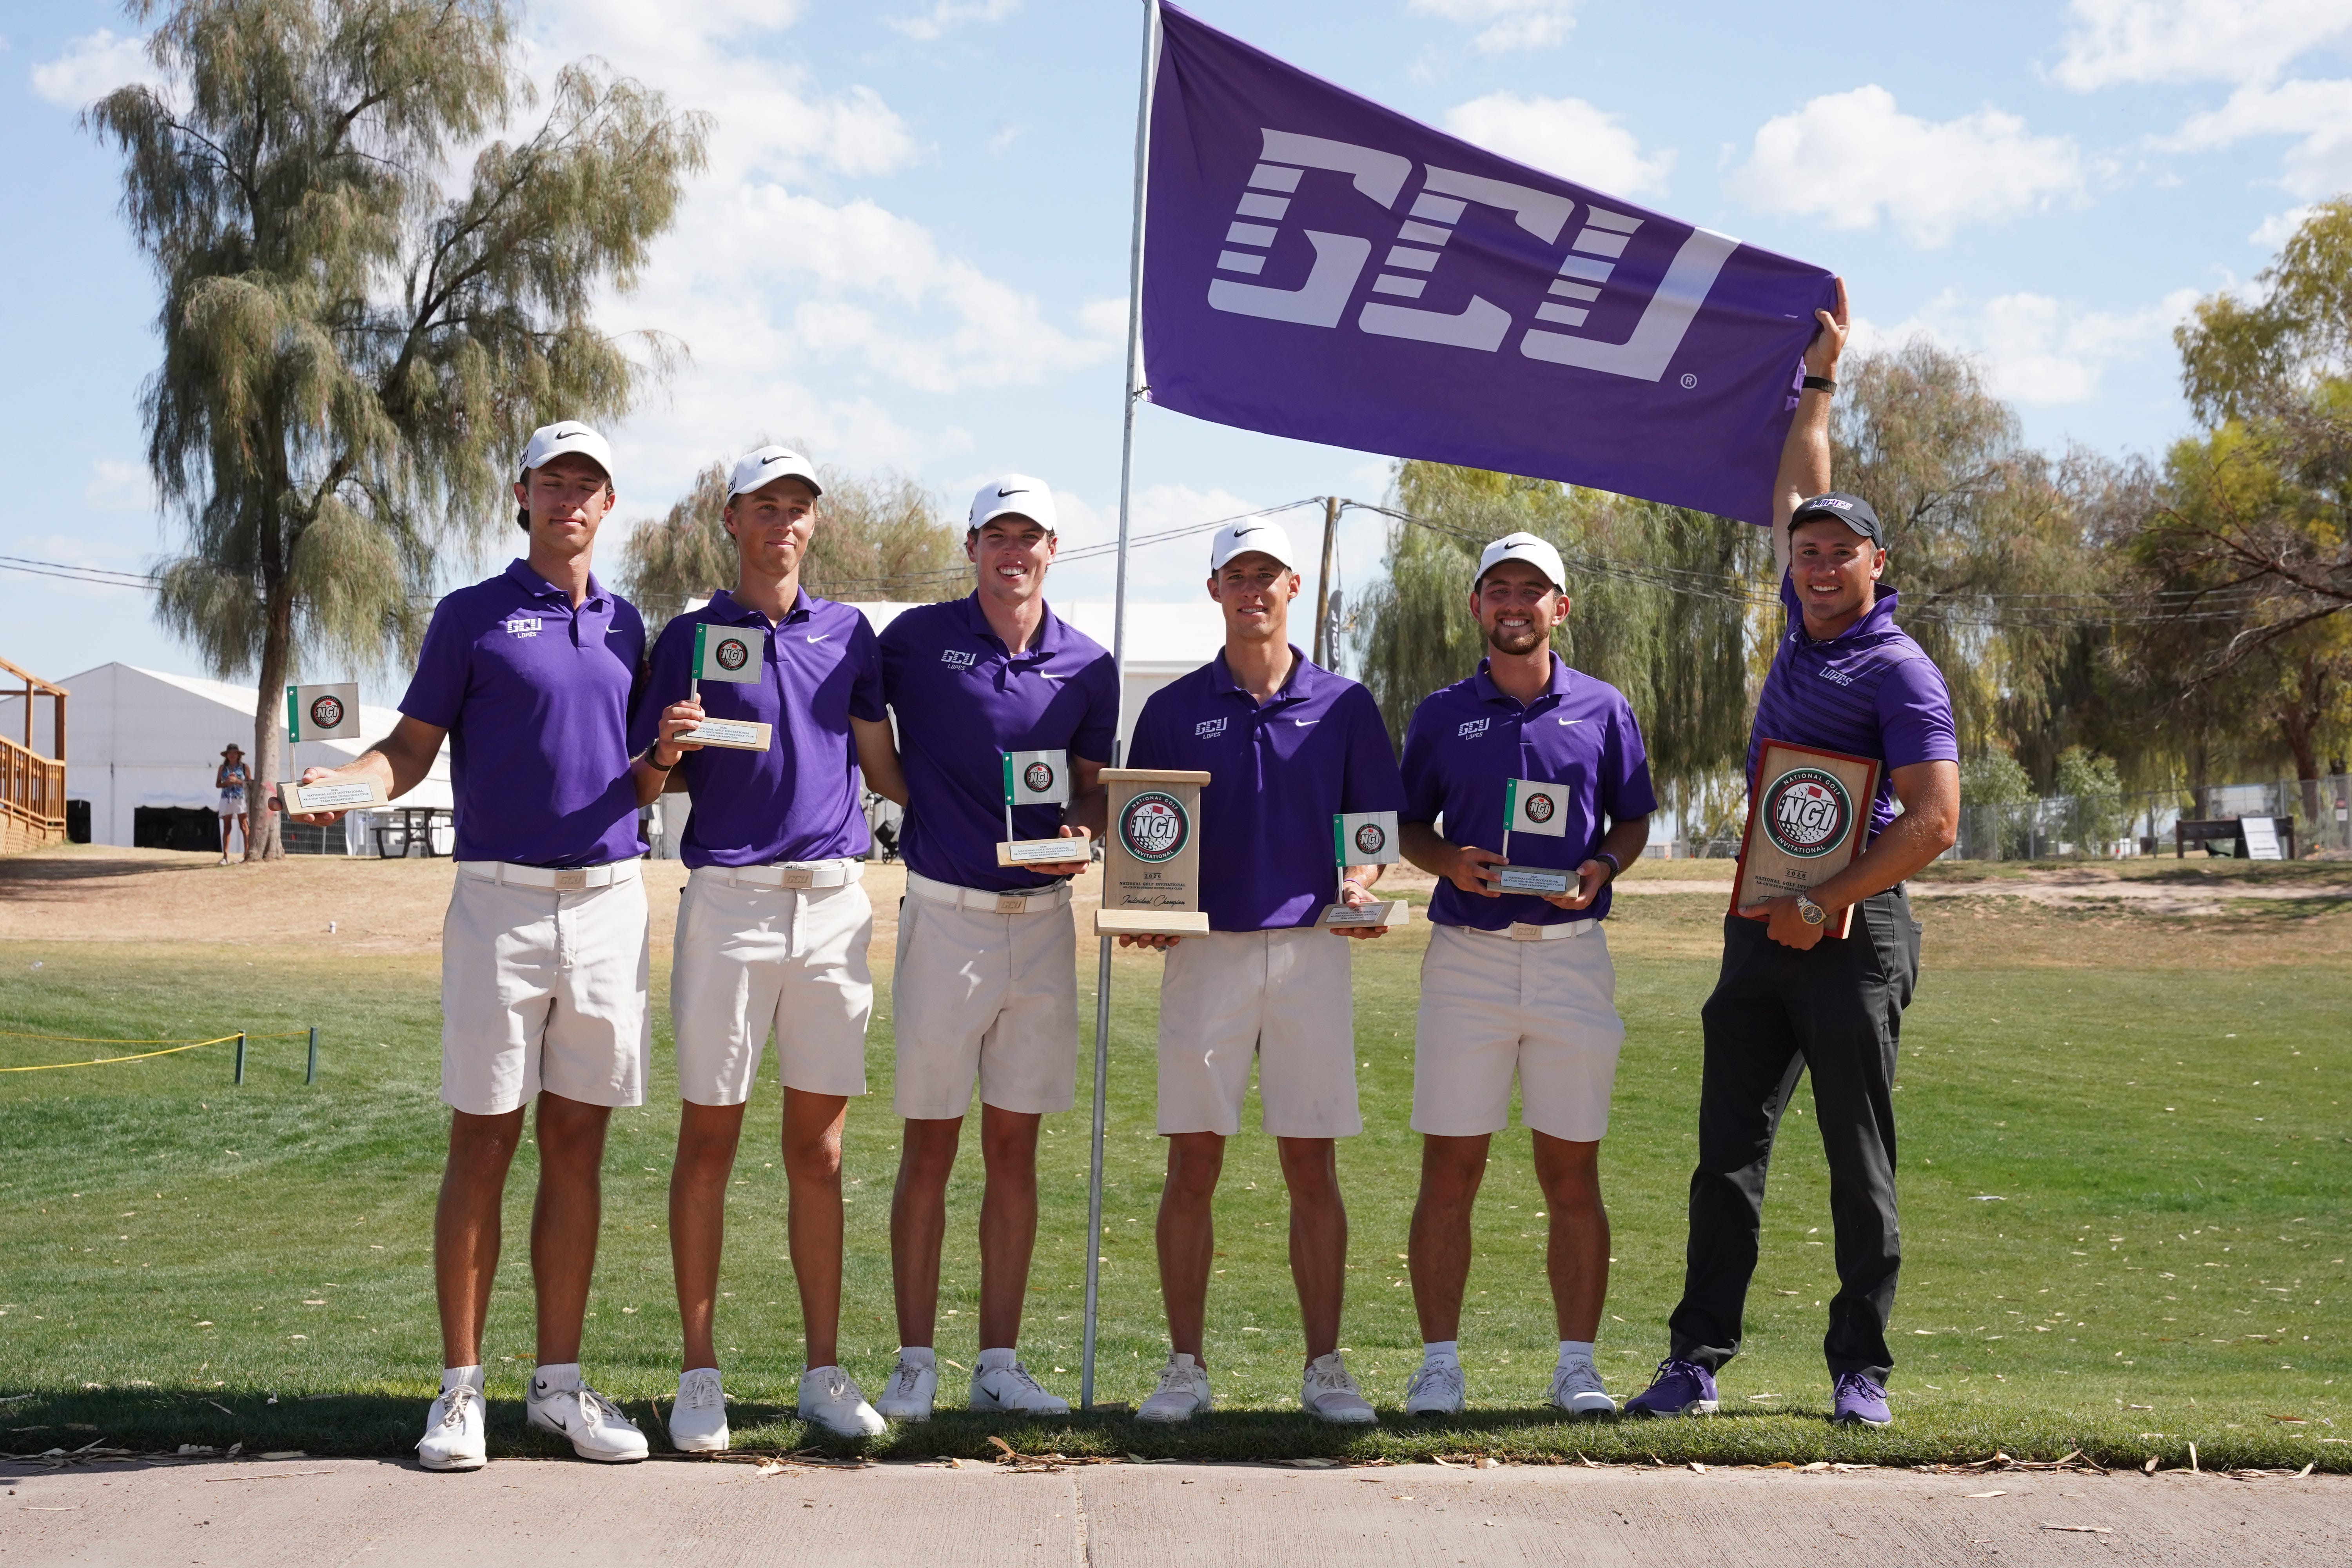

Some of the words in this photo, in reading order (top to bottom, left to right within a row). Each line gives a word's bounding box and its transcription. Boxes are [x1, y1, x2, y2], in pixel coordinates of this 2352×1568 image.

[1208, 127, 1742, 382] GCU
[1809, 498, 1853, 510] LOPES
[507, 618, 542, 633] GCU
[722, 648, 743, 661] NGI
[941, 650, 977, 665] GCU
[1819, 667, 1853, 686] LOPES
[317, 706, 338, 718] NGI
[1195, 717, 1228, 735] GCU
[1458, 717, 1490, 736] GCU
[1030, 772, 1048, 782] NGI
[1783, 773, 1822, 785] NATIONAL
[1825, 780, 1841, 795] GOLF
[1132, 796, 1161, 808] NATIONAL
[1165, 799, 1178, 810] GOLF
[1530, 802, 1550, 814] NGI
[1779, 796, 1837, 831] NGI
[1132, 816, 1176, 838] NGI
[1361, 833, 1379, 844] NGI
[1777, 836, 1826, 853] INVITATIONAL
[1134, 848, 1174, 859] INVITATIONAL
[1755, 875, 1780, 884] NATIONAL
[1120, 895, 1153, 906] Individual
[1154, 895, 1185, 907] Champion
[1428, 1359, 1445, 1368] Victory
